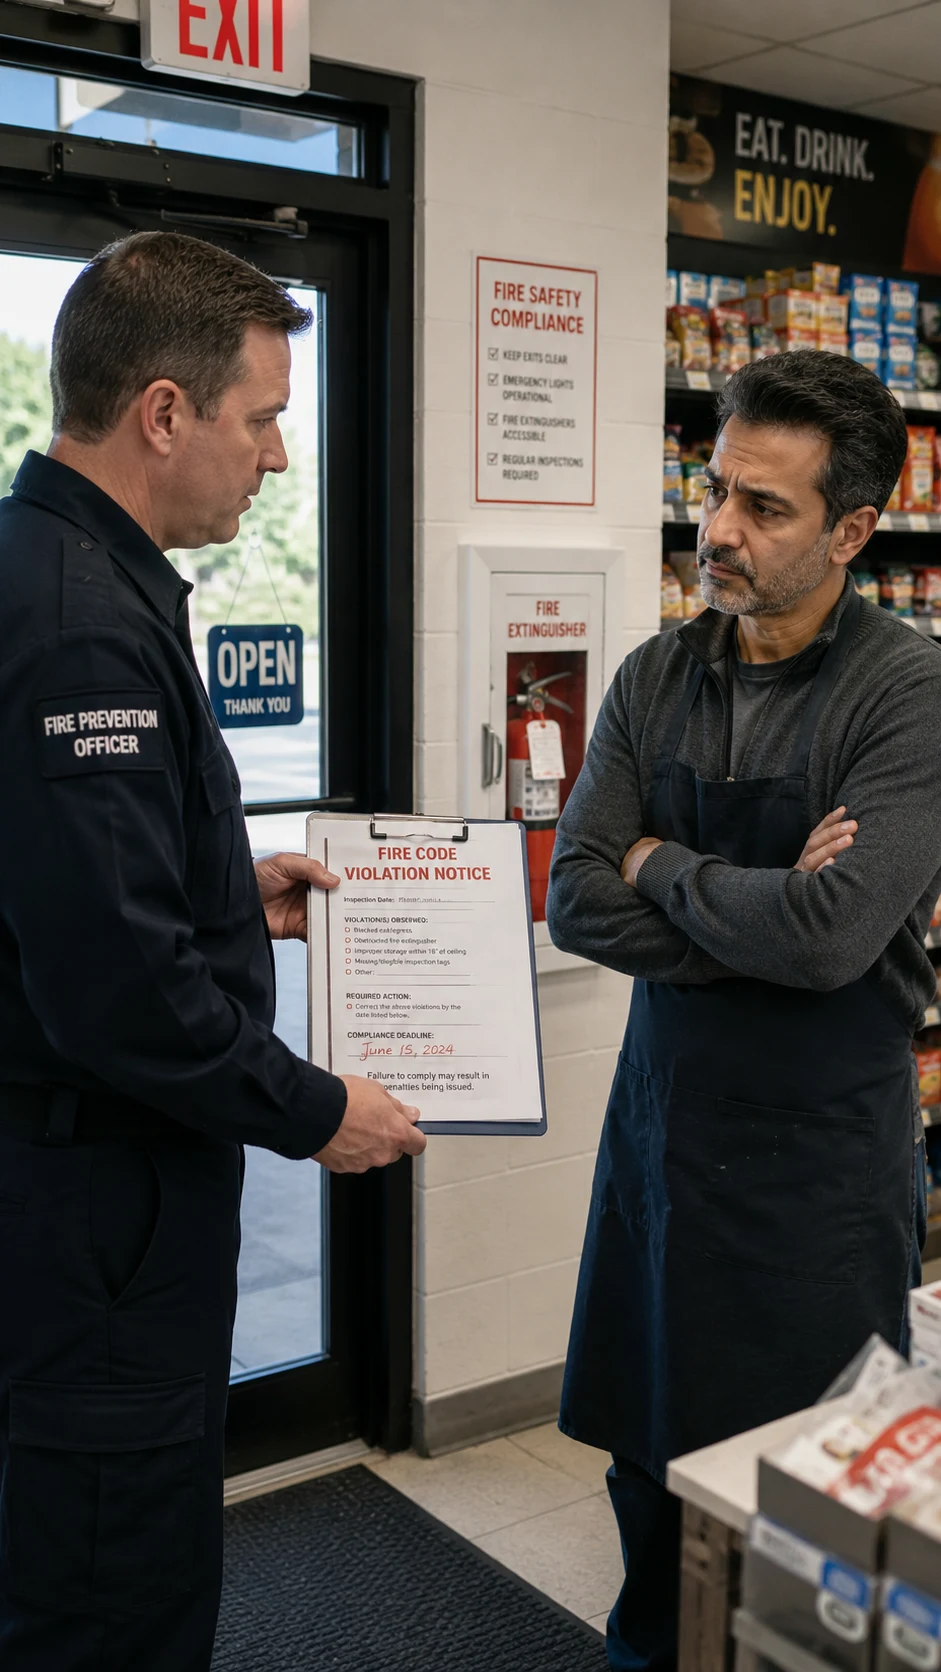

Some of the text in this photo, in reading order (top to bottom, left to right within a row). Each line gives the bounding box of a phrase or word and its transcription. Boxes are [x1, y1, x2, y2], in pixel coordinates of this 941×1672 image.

[735, 112, 874, 181] EAT. DRINK.
[735, 168, 836, 236] ENJOY.
[494, 280, 582, 309] FIRE SAFETY
[490, 307, 584, 334] COMPLIANCE
[503, 350, 568, 364] KEEP EXITS CLEAR
[503, 375, 574, 390] EMERGENCY LIGHTS
[502, 390, 552, 403] OPERATIONAL
[502, 414, 576, 429] FIRE EXTINGUISHERS
[502, 430, 546, 442] ACCESSIBLE
[502, 454, 584, 468] REGULAR INSPECTIONS
[502, 469, 539, 481] REQUIRED
[536, 601, 560, 617] FIRE
[508, 623, 586, 638] EXTINGUISHER
[217, 640, 296, 688] OPEN
[224, 697, 291, 716] THANK YOU
[44, 710, 158, 736] FIRE PREVENTION
[74, 735, 139, 757] OFFICER
[378, 847, 457, 860] FIRE CODE
[344, 867, 491, 881] VIOLATION NOTICE
[344, 896, 377, 904] Inspection
[359, 1042, 456, 1061] June 15, 2024
[367, 1072, 395, 1080] Failure
[406, 1072, 436, 1081] comply
[457, 1072, 480, 1080] result
[482, 1072, 490, 1080] in
[421, 1083, 444, 1093] being
[446, 1083, 475, 1091] issued.
